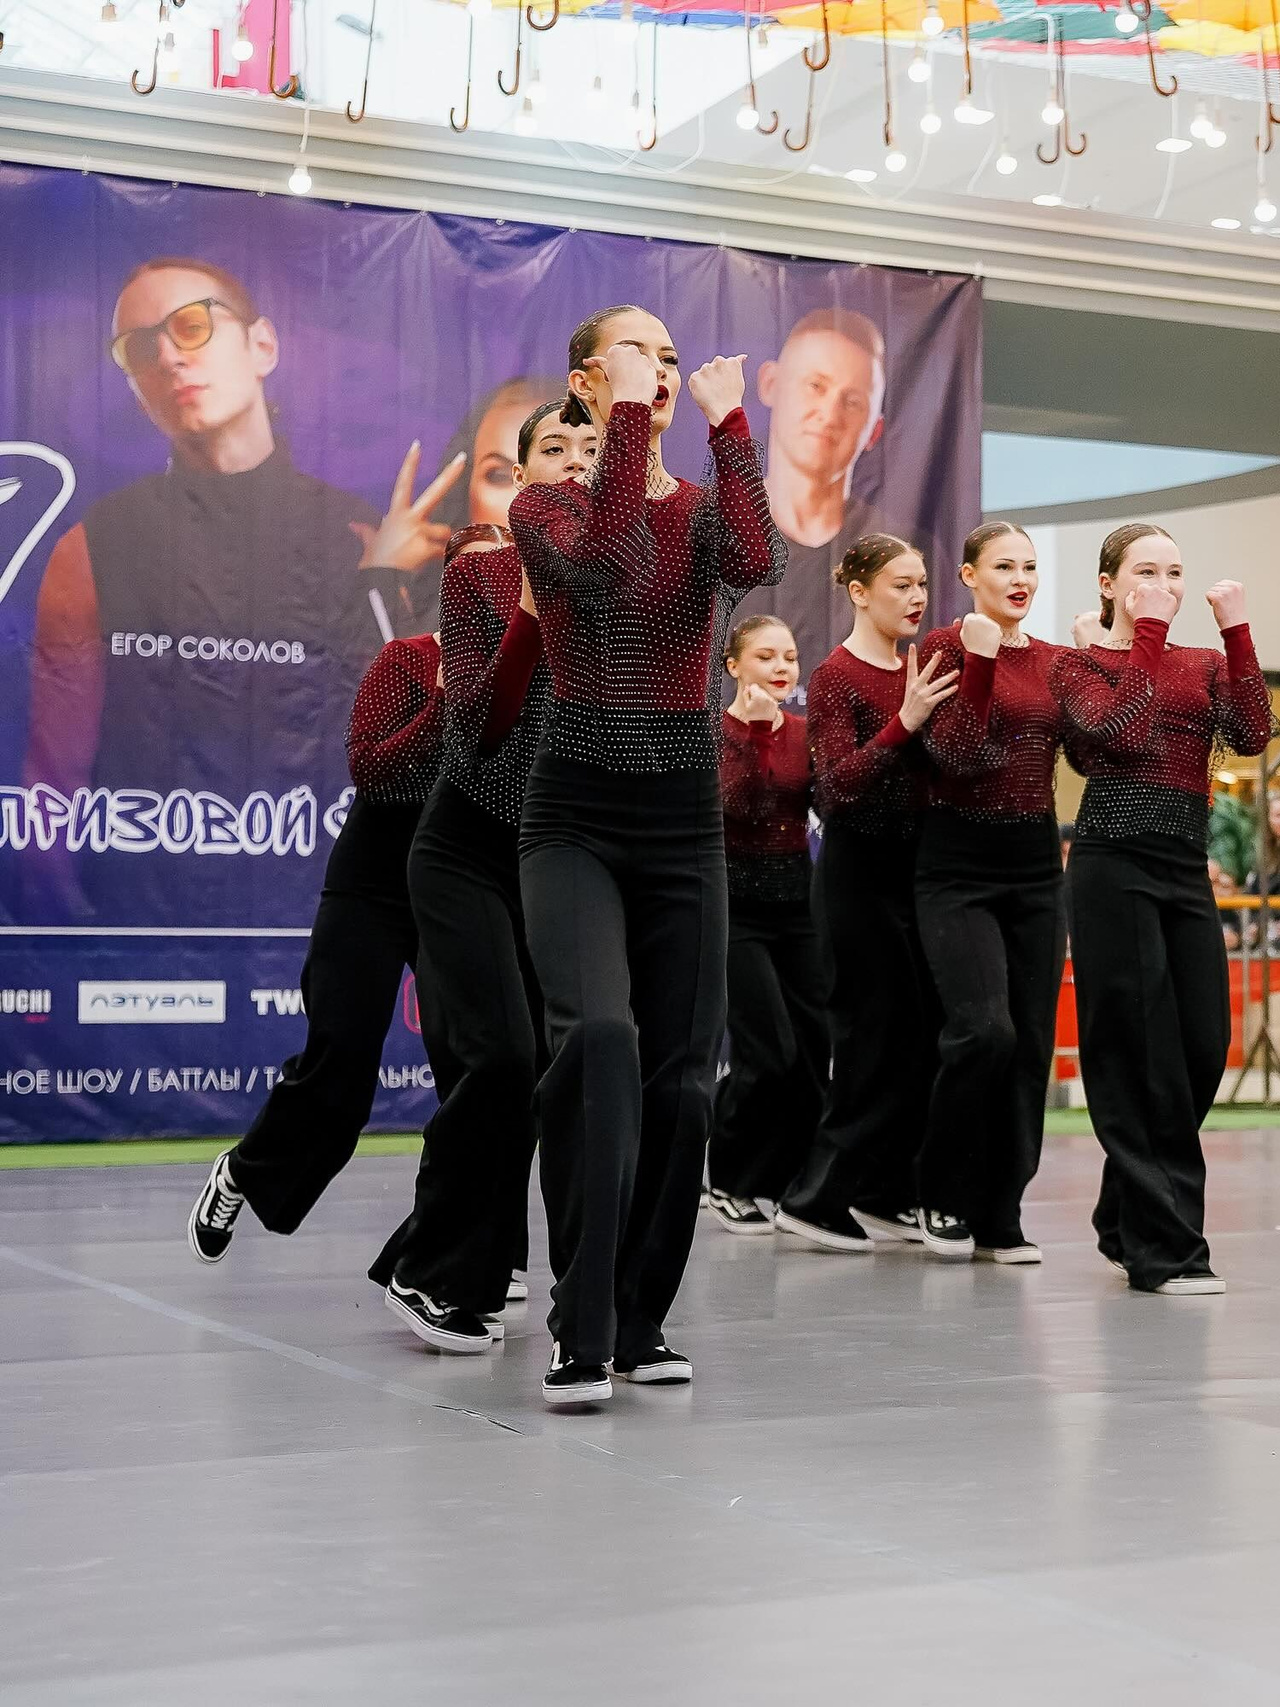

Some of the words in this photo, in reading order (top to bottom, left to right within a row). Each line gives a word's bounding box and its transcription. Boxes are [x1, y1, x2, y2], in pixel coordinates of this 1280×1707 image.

[111, 632, 172, 658] ЕГОР
[178, 635, 306, 664] СОКОЛОВ
[0, 782, 317, 857] ПРИЗОВОЙ
[0, 989, 51, 1014] UCHI
[250, 989, 306, 1016] TW
[57, 1068, 123, 1094] ШОУ
[148, 1066, 241, 1093] БАТТЛЫ
